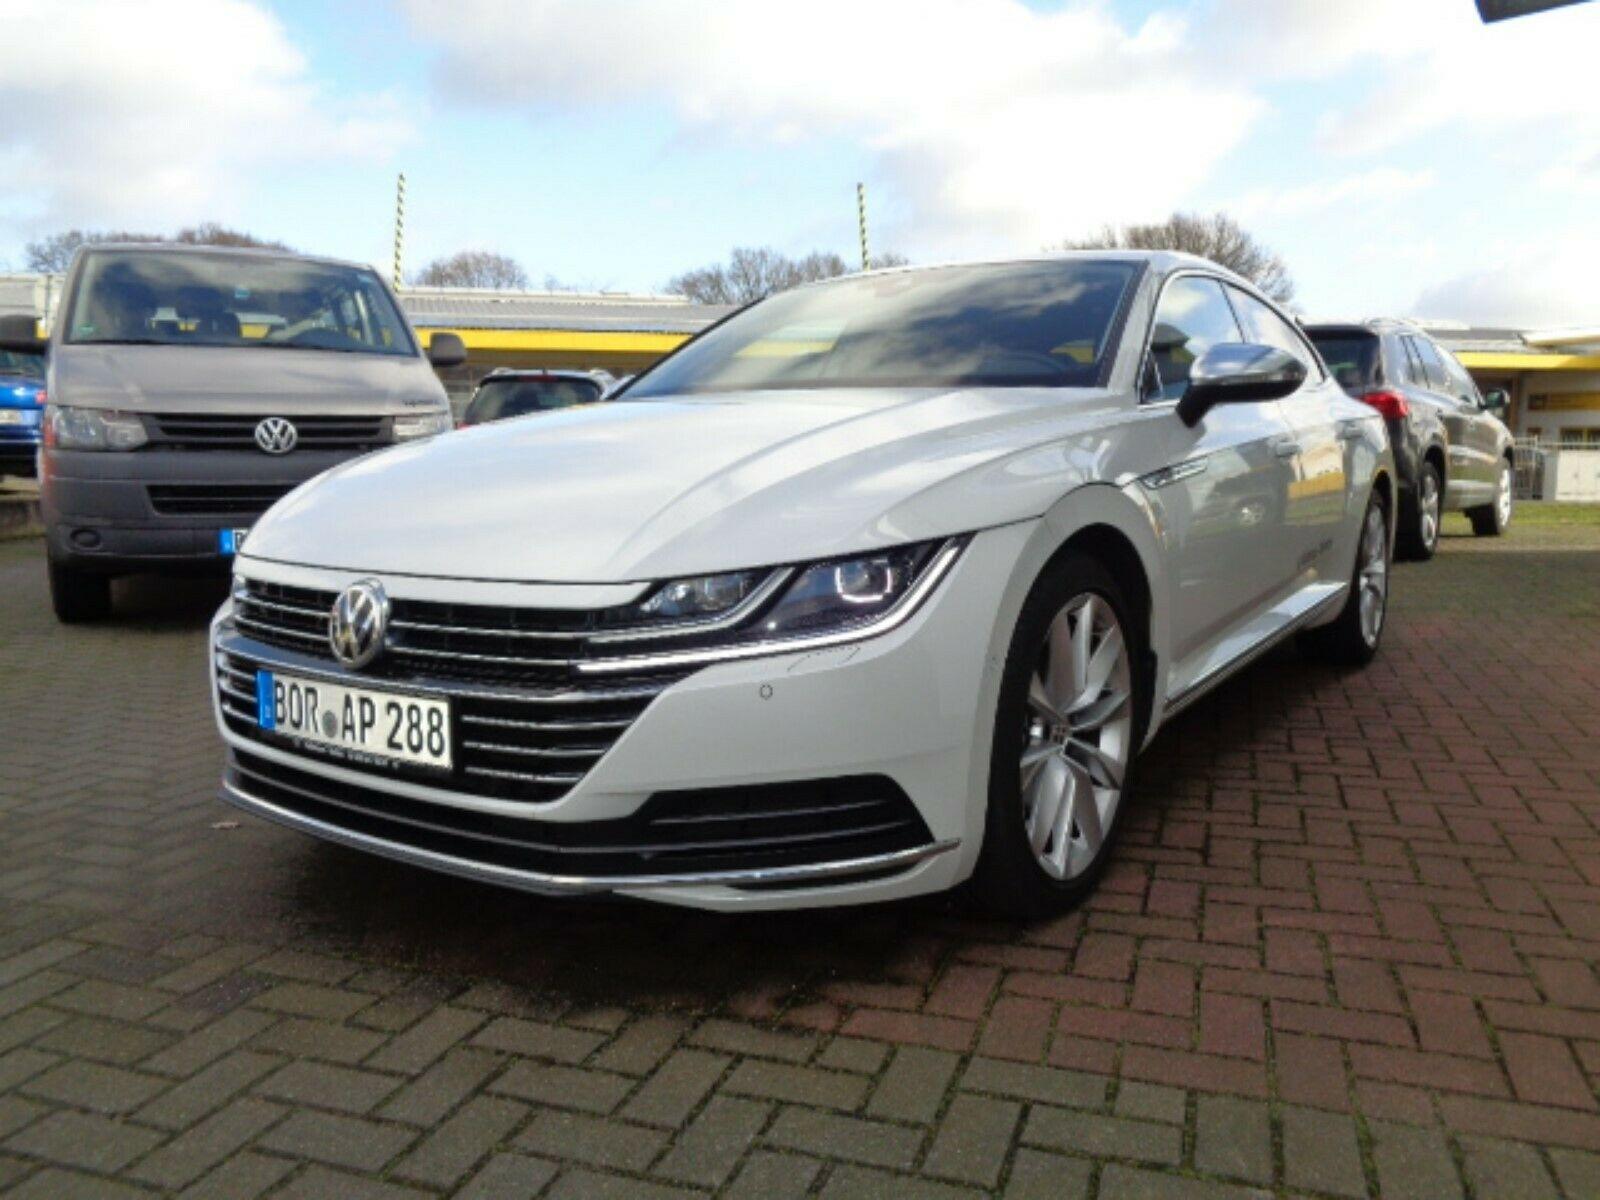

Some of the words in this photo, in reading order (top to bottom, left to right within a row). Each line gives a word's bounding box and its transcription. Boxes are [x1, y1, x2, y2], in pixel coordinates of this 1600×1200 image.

[255, 417, 297, 453] VW
[330, 582, 387, 669] VW
[275, 681, 319, 734] BOR
[341, 694, 376, 744] AP
[386, 701, 446, 759] 288
